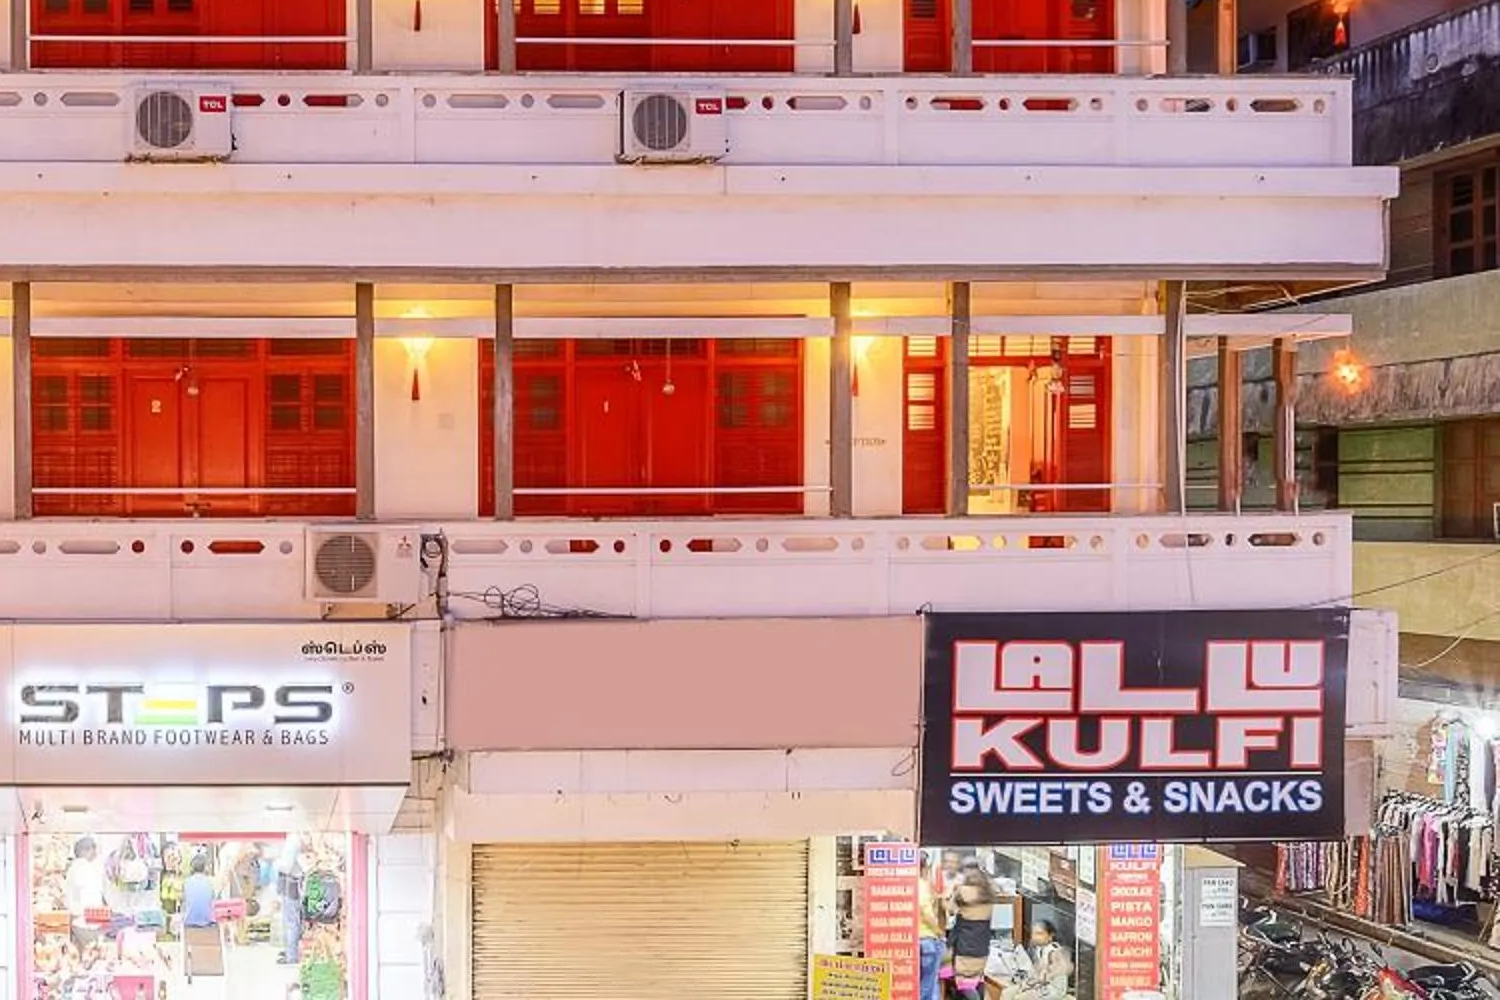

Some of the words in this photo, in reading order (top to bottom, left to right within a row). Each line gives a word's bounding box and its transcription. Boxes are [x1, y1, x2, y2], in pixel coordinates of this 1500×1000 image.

[203, 100, 224, 109] TCL
[698, 102, 719, 111] TCL
[301, 640, 387, 655] ஸ்டெப்ஸ்
[953, 639, 1325, 714] LALLU
[19, 684, 333, 724] STEPS
[19, 730, 75, 745] MULTI
[83, 729, 147, 745] BRAND
[154, 730, 255, 746] FOOTWEAR
[261, 730, 273, 745] &
[281, 730, 329, 745] BAGS
[950, 716, 1324, 770] KULFI
[950, 781, 1112, 814] SWEETS
[1122, 781, 1151, 813] &
[1164, 780, 1323, 812] SNACKS
[1110, 902, 1153, 913] PISTA
[1111, 918, 1153, 928] MANGO
